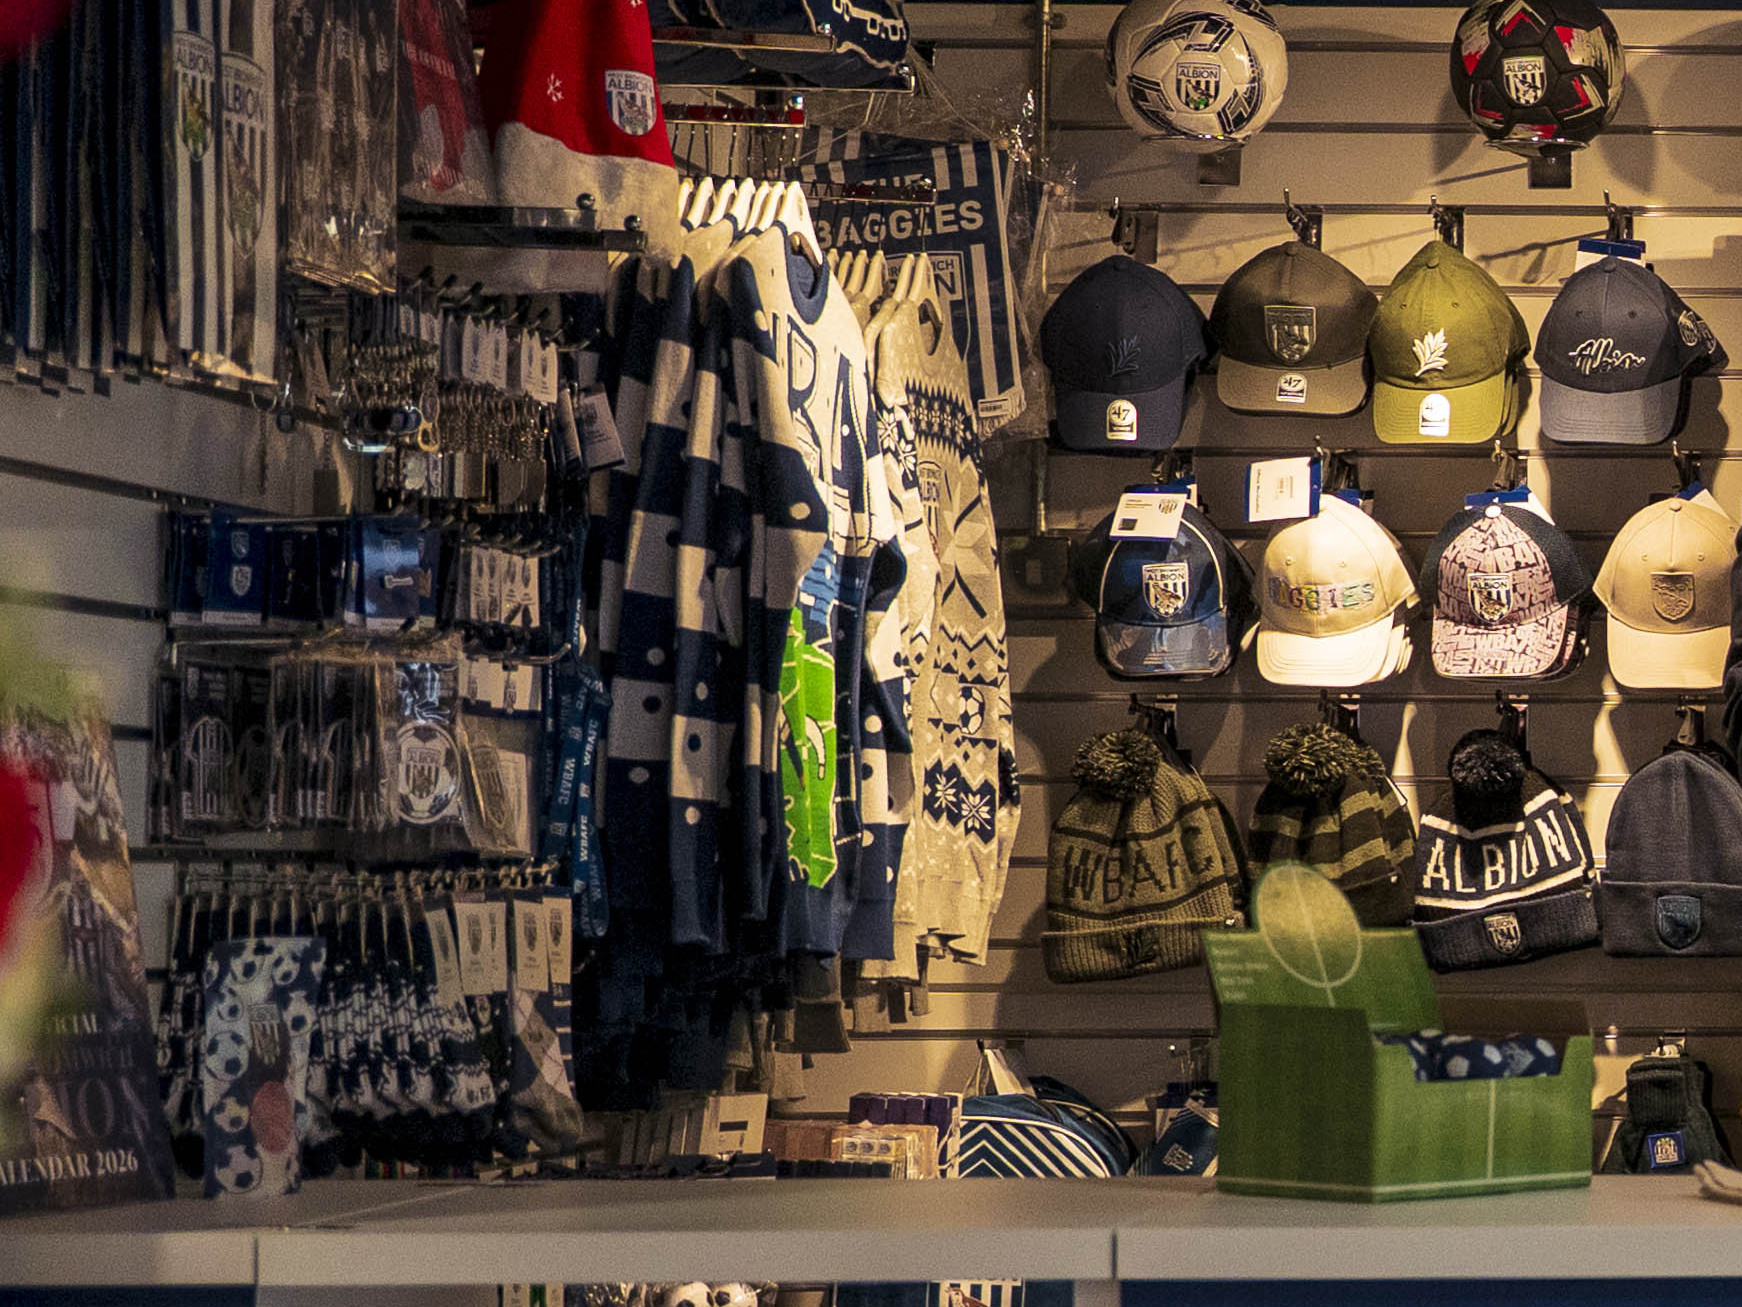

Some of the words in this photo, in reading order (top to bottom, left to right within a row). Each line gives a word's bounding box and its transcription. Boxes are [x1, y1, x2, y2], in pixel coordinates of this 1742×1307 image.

[1179, 69, 1219, 79] ALBION
[1421, 809, 1572, 893] ALBION
[96, 1149, 139, 1176] 2026
